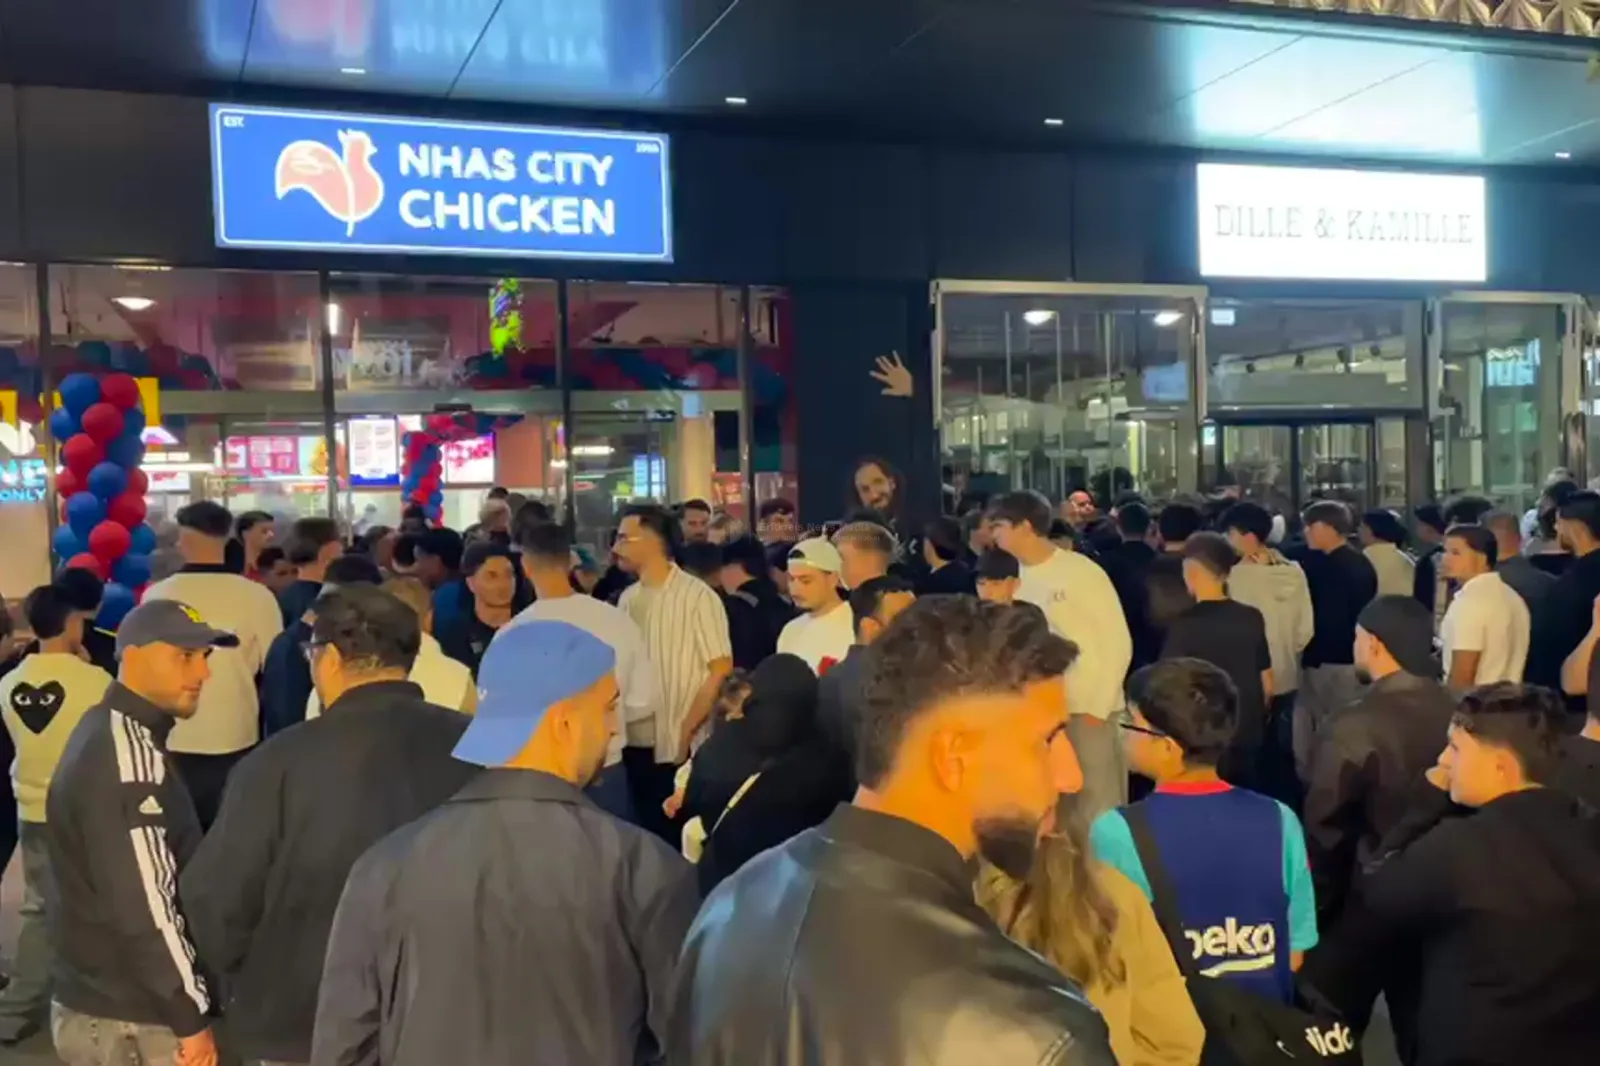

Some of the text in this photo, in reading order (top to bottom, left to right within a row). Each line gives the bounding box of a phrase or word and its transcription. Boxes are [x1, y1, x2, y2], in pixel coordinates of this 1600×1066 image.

[399, 142, 613, 186] NHAS CITY
[399, 189, 615, 236] CHICKEN
[1214, 204, 1473, 243] DILLE & KAMILLE
